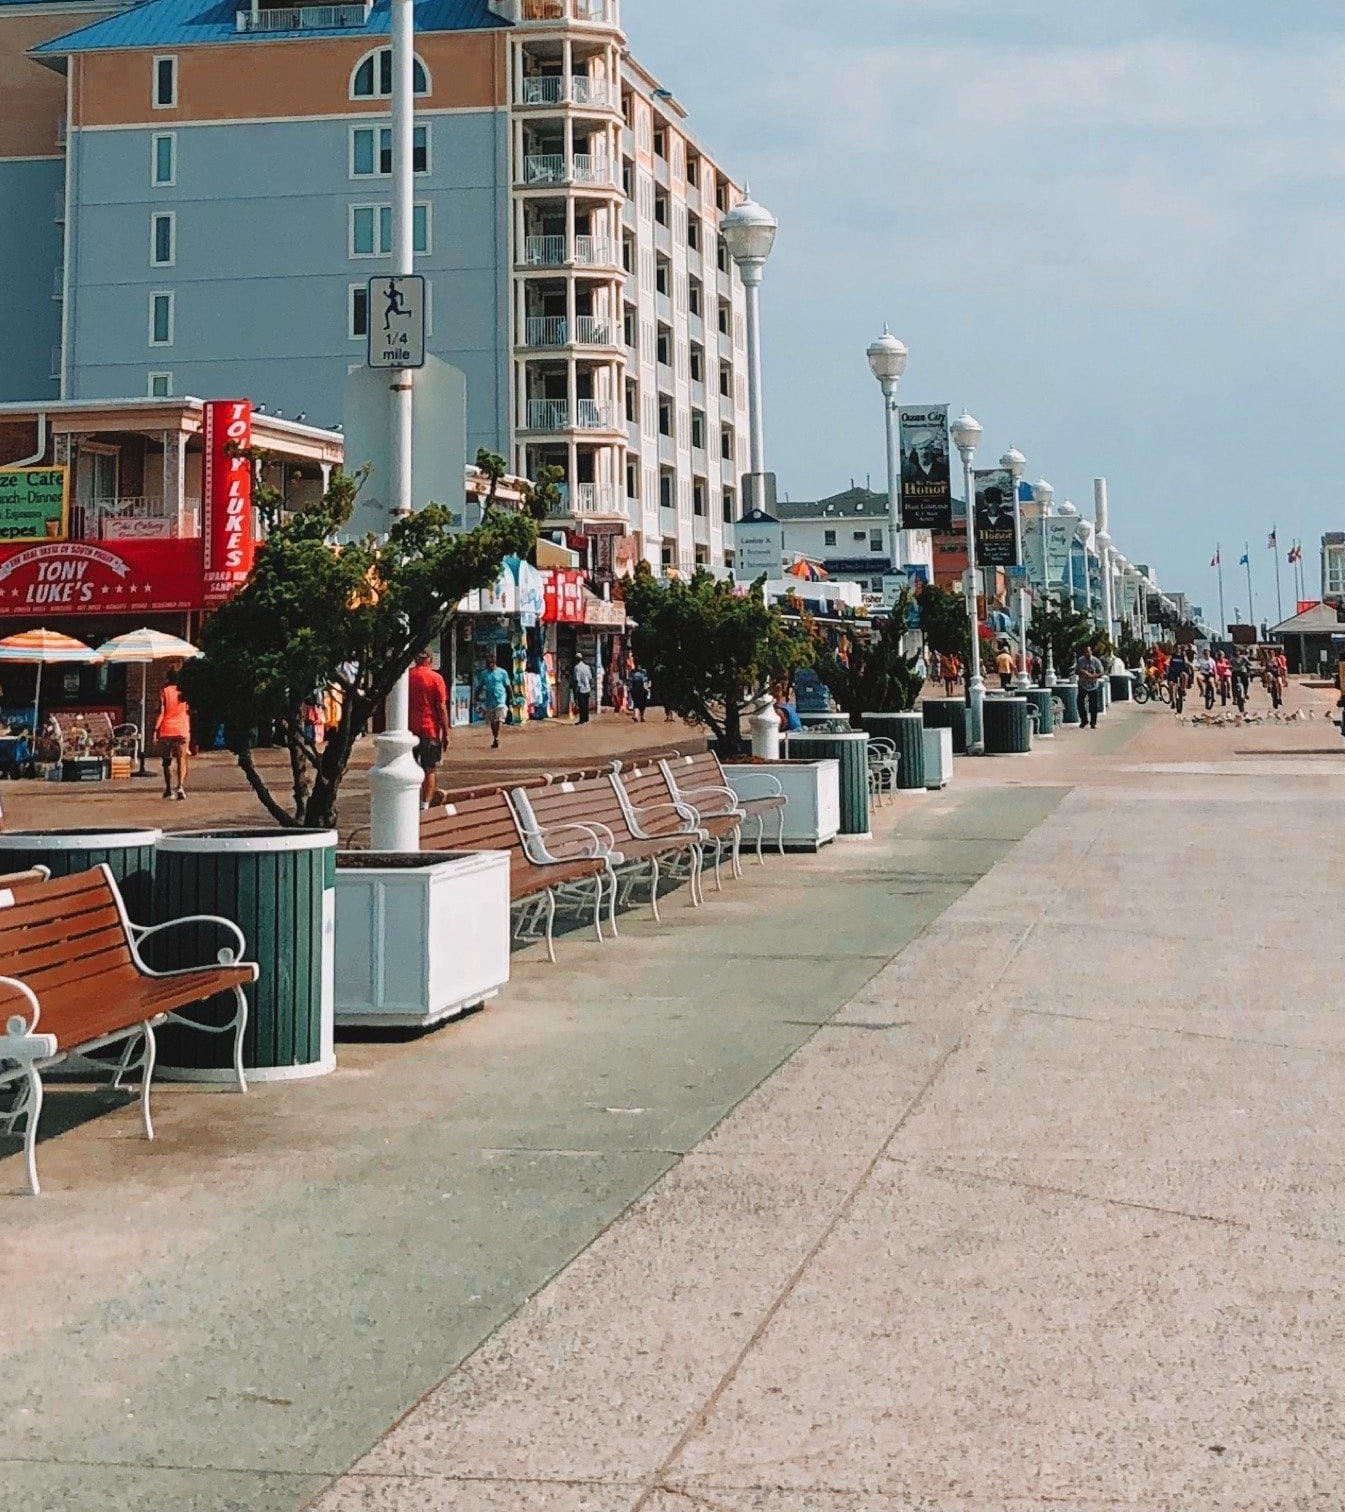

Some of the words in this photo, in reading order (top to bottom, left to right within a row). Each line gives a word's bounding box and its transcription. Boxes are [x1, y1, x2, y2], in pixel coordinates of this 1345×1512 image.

[386, 332, 408, 345] 1/4
[383, 347, 410, 360] mile
[905, 482, 947, 496] Honor
[225, 480, 247, 568] LUKES
[38, 561, 89, 582] TONY
[26, 581, 95, 604] LUKE'S
